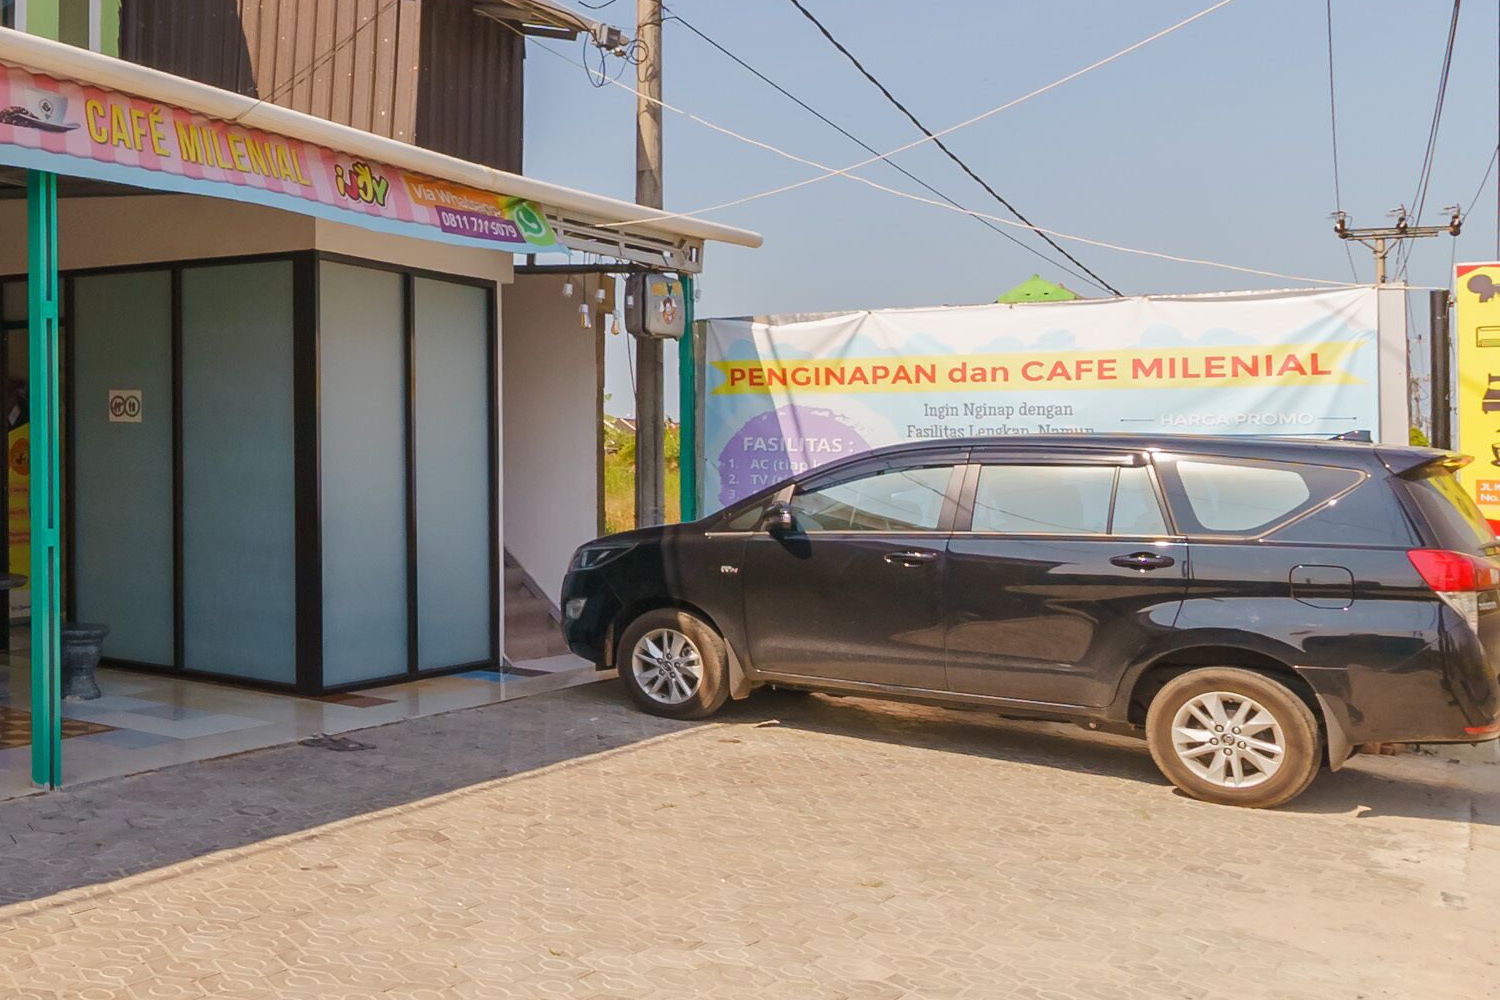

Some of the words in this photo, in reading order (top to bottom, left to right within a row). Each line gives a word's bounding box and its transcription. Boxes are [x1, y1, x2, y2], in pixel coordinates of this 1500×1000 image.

[84, 99, 171, 157] CAFÉ
[174, 122, 312, 186] MILENIAL
[410, 182, 435, 201] Via
[441, 211, 469, 231] 0811
[729, 364, 936, 387] PENGINAPAN
[948, 362, 1009, 383] dan
[1020, 358, 1117, 382] CAFE
[1131, 353, 1332, 380] MILENIAL
[924, 403, 959, 419] Ingin
[963, 403, 1014, 419] Nginap
[1019, 402, 1073, 419] dengan
[1161, 413, 1230, 427] HARGA
[1236, 412, 1315, 426] PROMO
[907, 424, 965, 438] Fasilitas
[743, 437, 843, 452] FASILITAS
[750, 459, 770, 469] AC
[750, 475, 767, 485] TV
